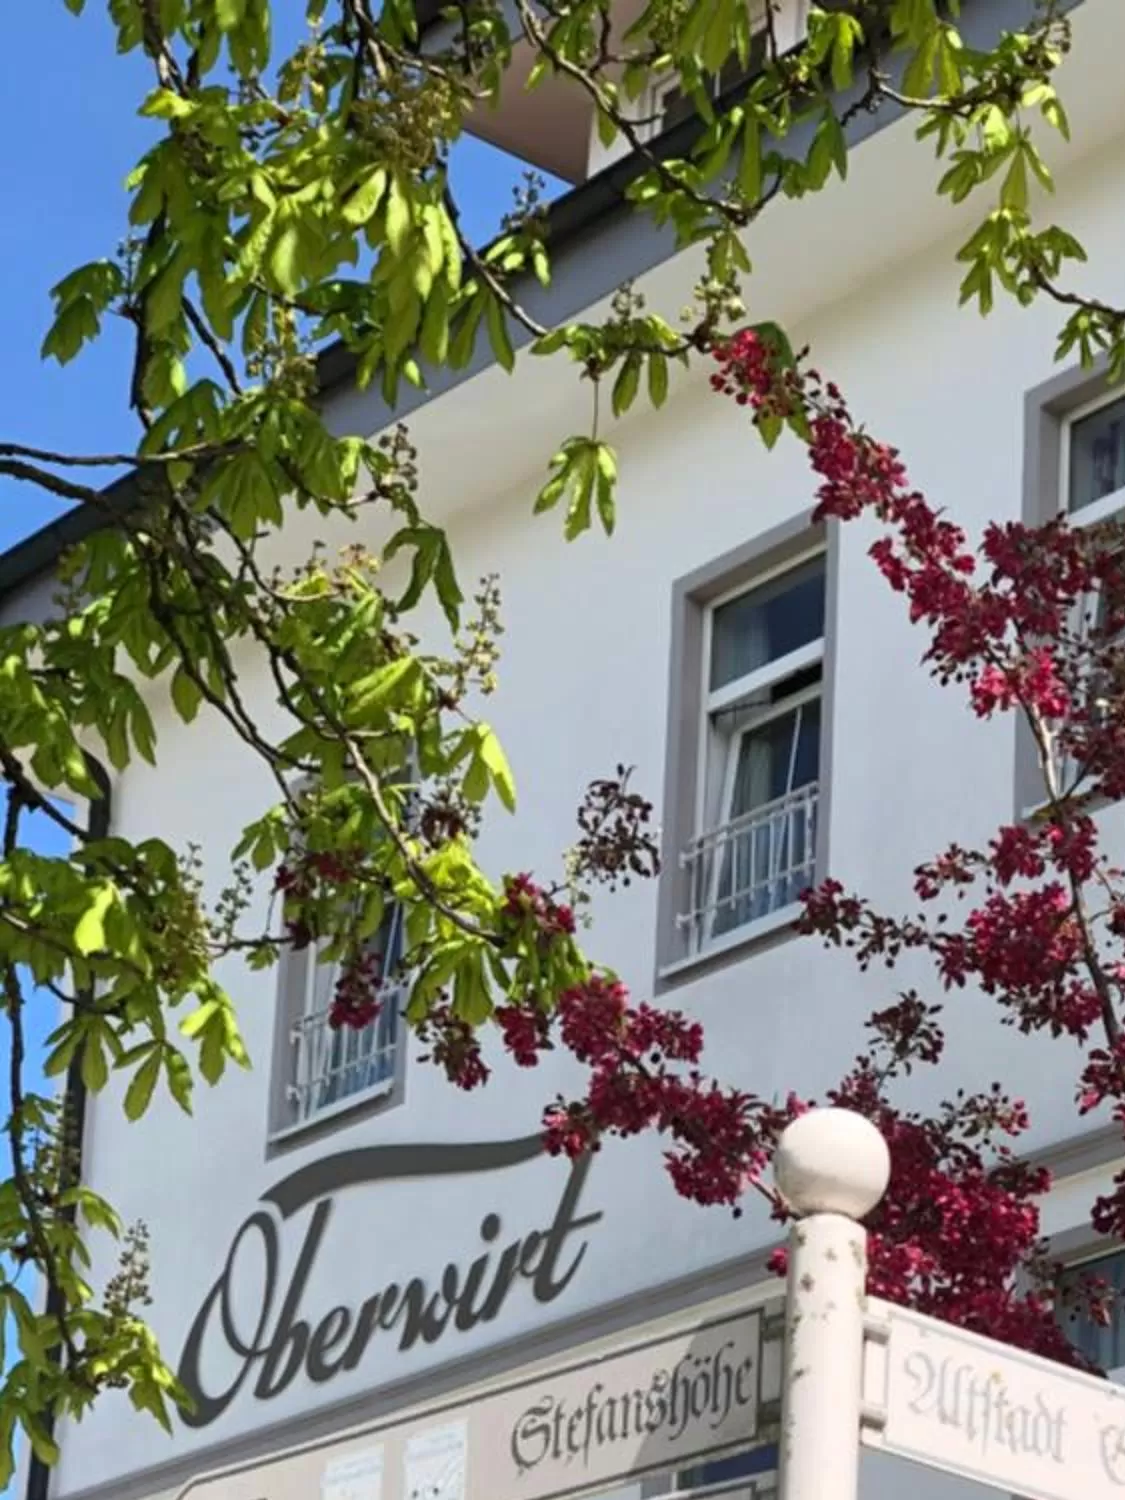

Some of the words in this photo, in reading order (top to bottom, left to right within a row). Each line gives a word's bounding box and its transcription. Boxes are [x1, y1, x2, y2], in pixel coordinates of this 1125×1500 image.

[177, 1133, 604, 1428] Oberwirt
[511, 1341, 753, 1476] Stefanshöhe
[903, 1351, 1069, 1463] Altstadt
